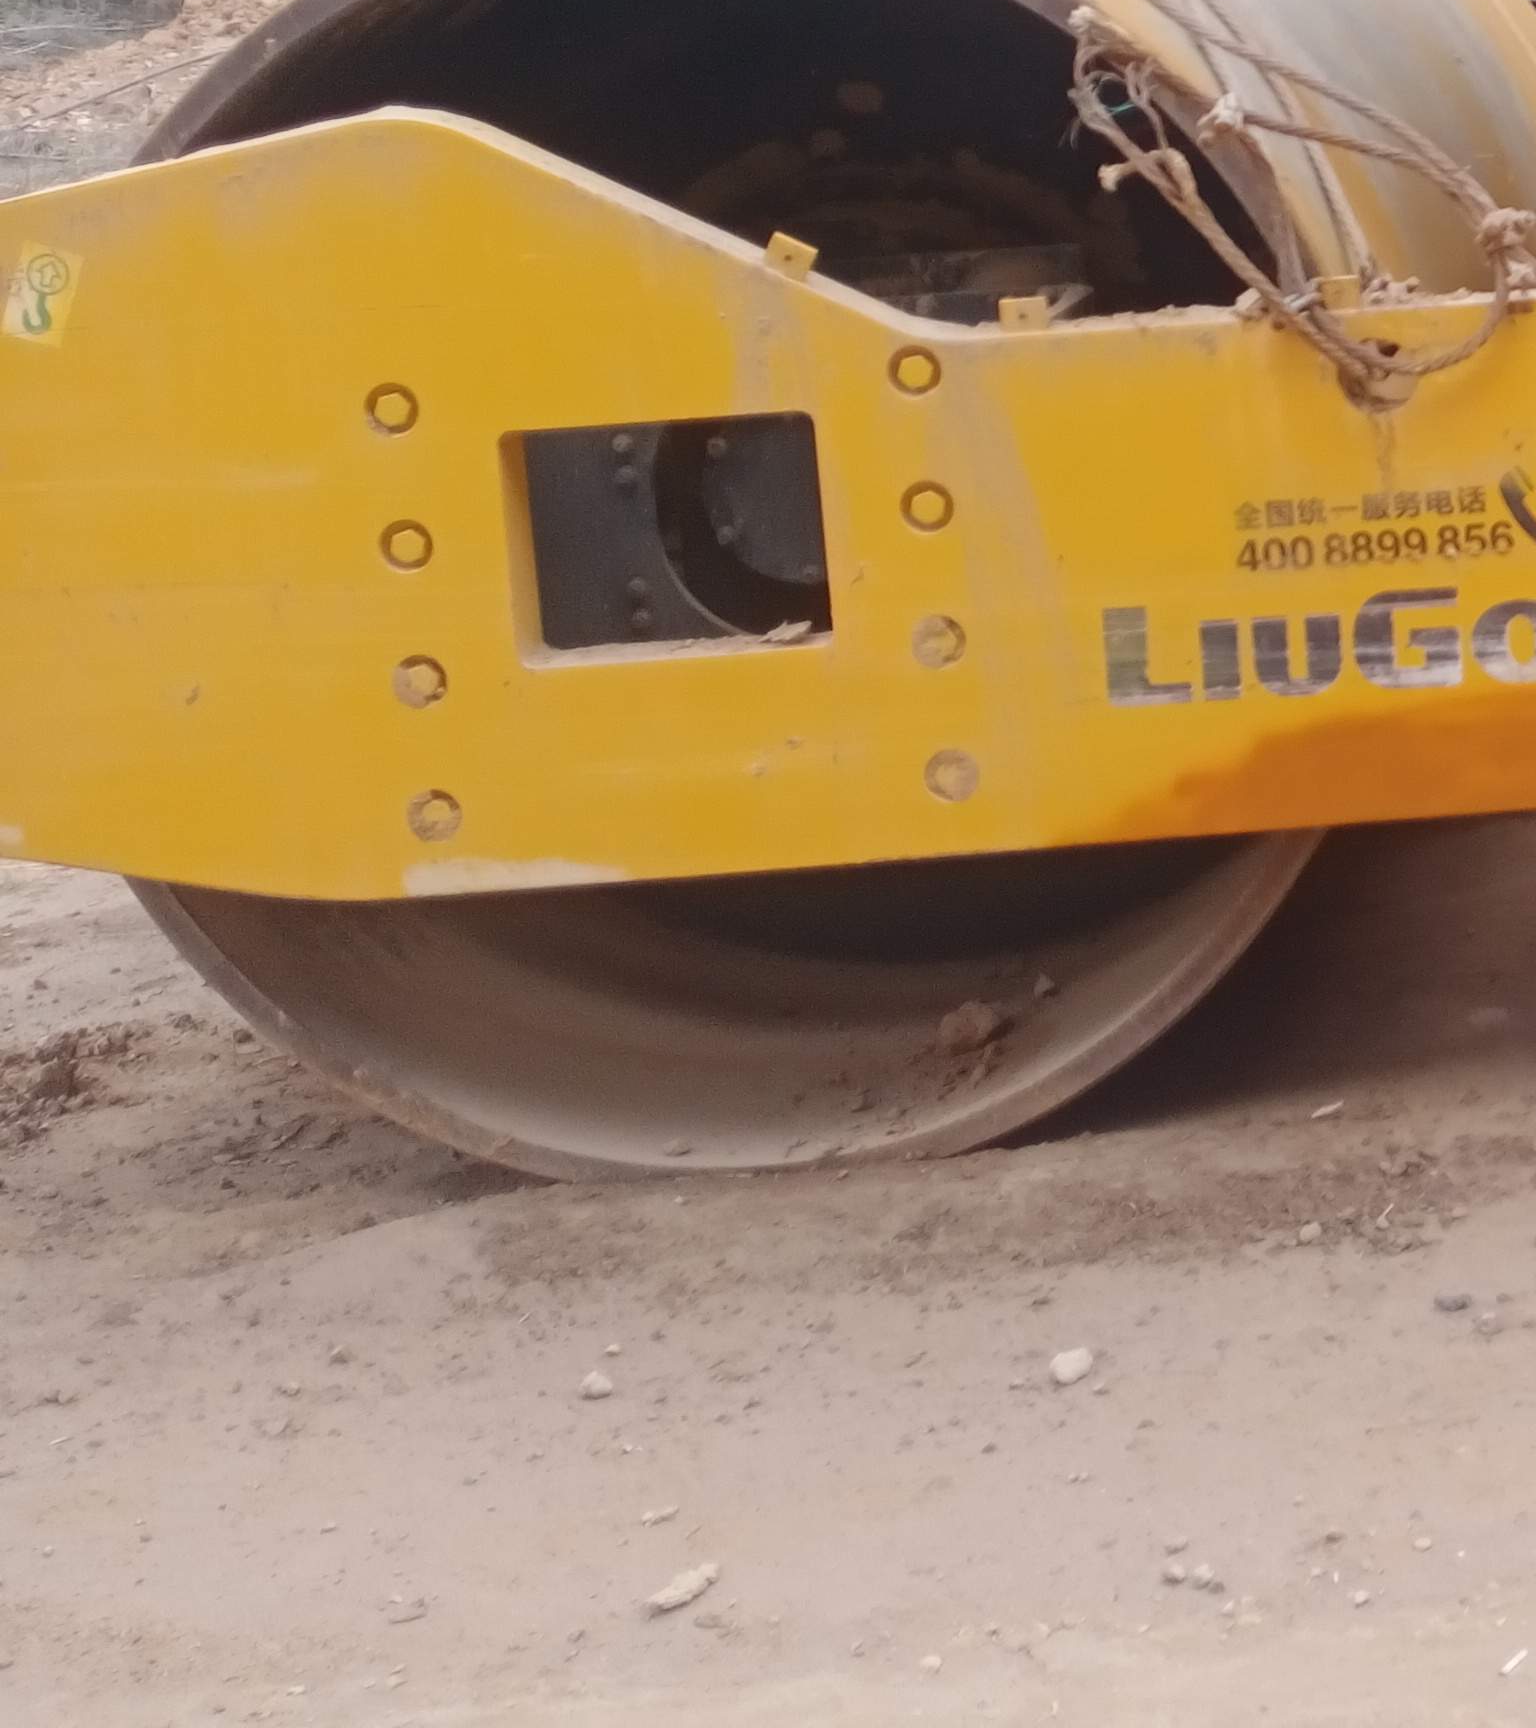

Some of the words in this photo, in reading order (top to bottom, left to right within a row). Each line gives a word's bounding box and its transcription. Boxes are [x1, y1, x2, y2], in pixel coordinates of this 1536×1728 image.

[1234, 485, 1487, 530] 全国统一服务电话
[1237, 535, 1315, 571] 400
[1324, 527, 1429, 564] 8899
[1436, 521, 1515, 560] 856
